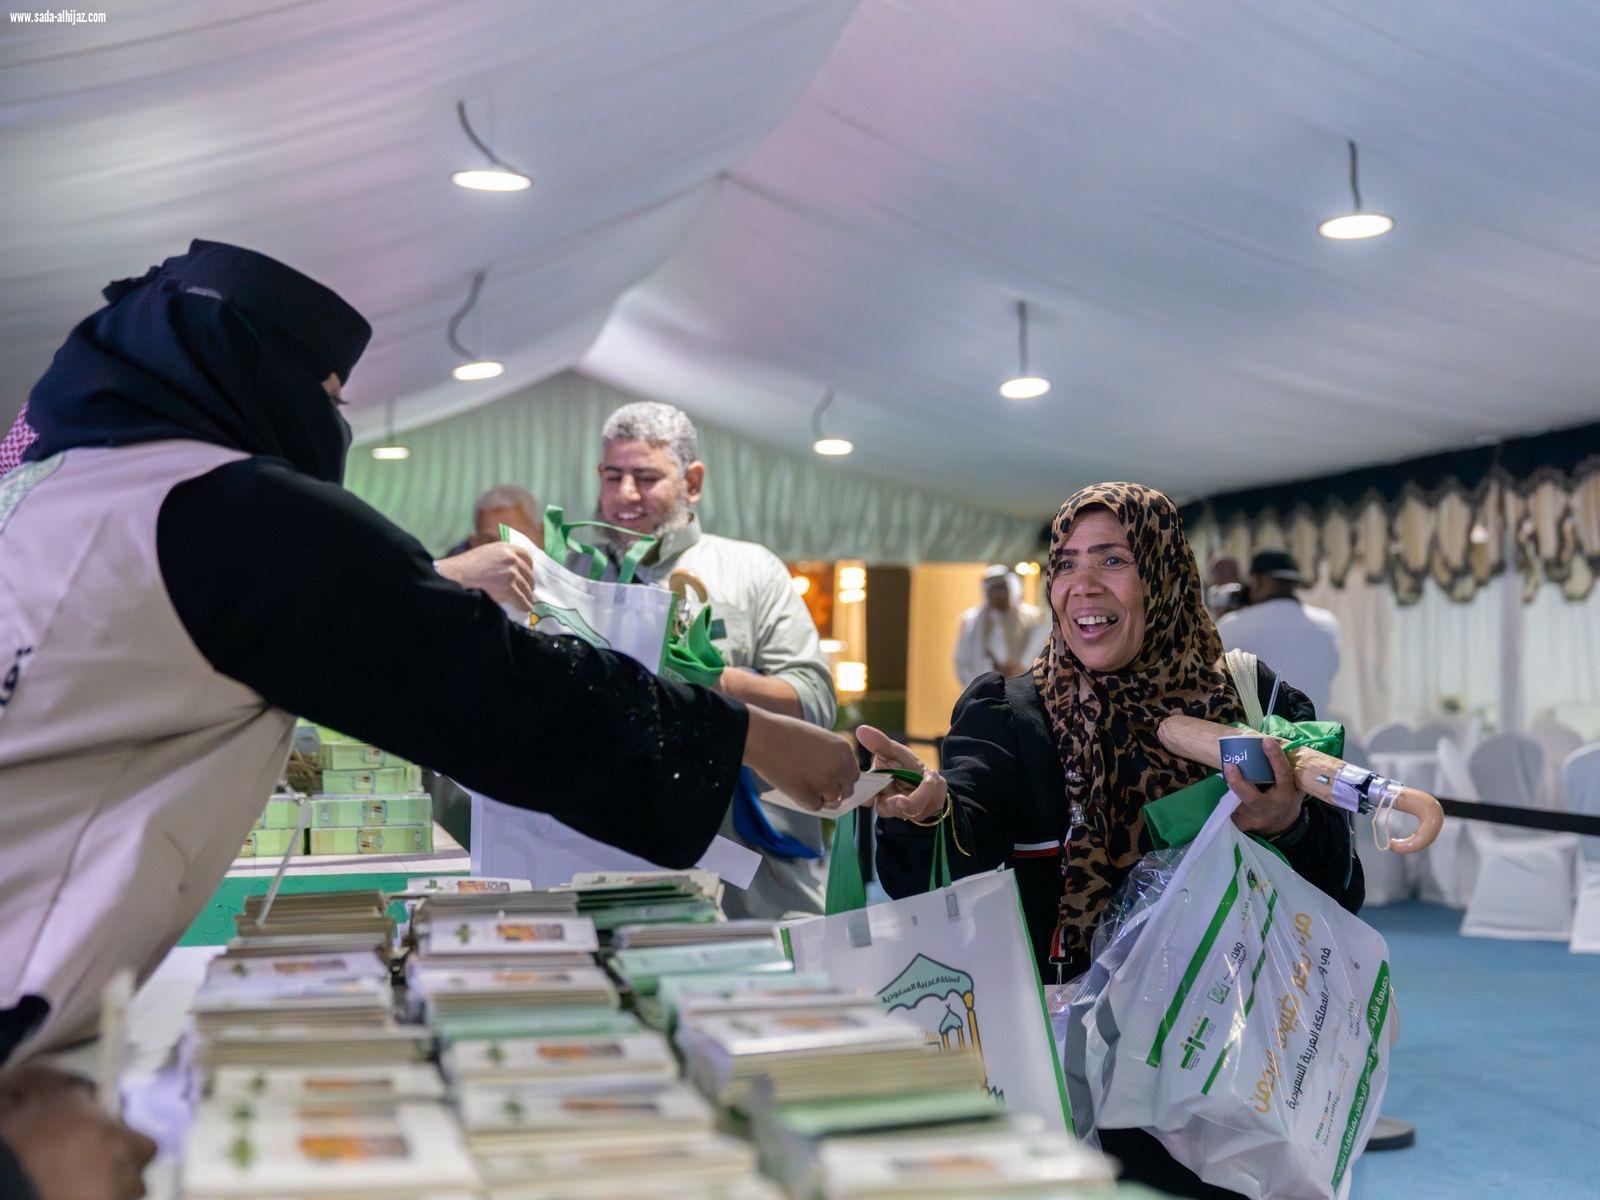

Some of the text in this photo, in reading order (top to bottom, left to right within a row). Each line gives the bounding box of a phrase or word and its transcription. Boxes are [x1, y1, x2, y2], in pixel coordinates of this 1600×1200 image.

[1319, 947, 1332, 966] في
[1312, 991, 1329, 1031] المملكة
[1300, 1029, 1320, 1064] العربية
[1286, 1062, 1308, 1110] السعودية
